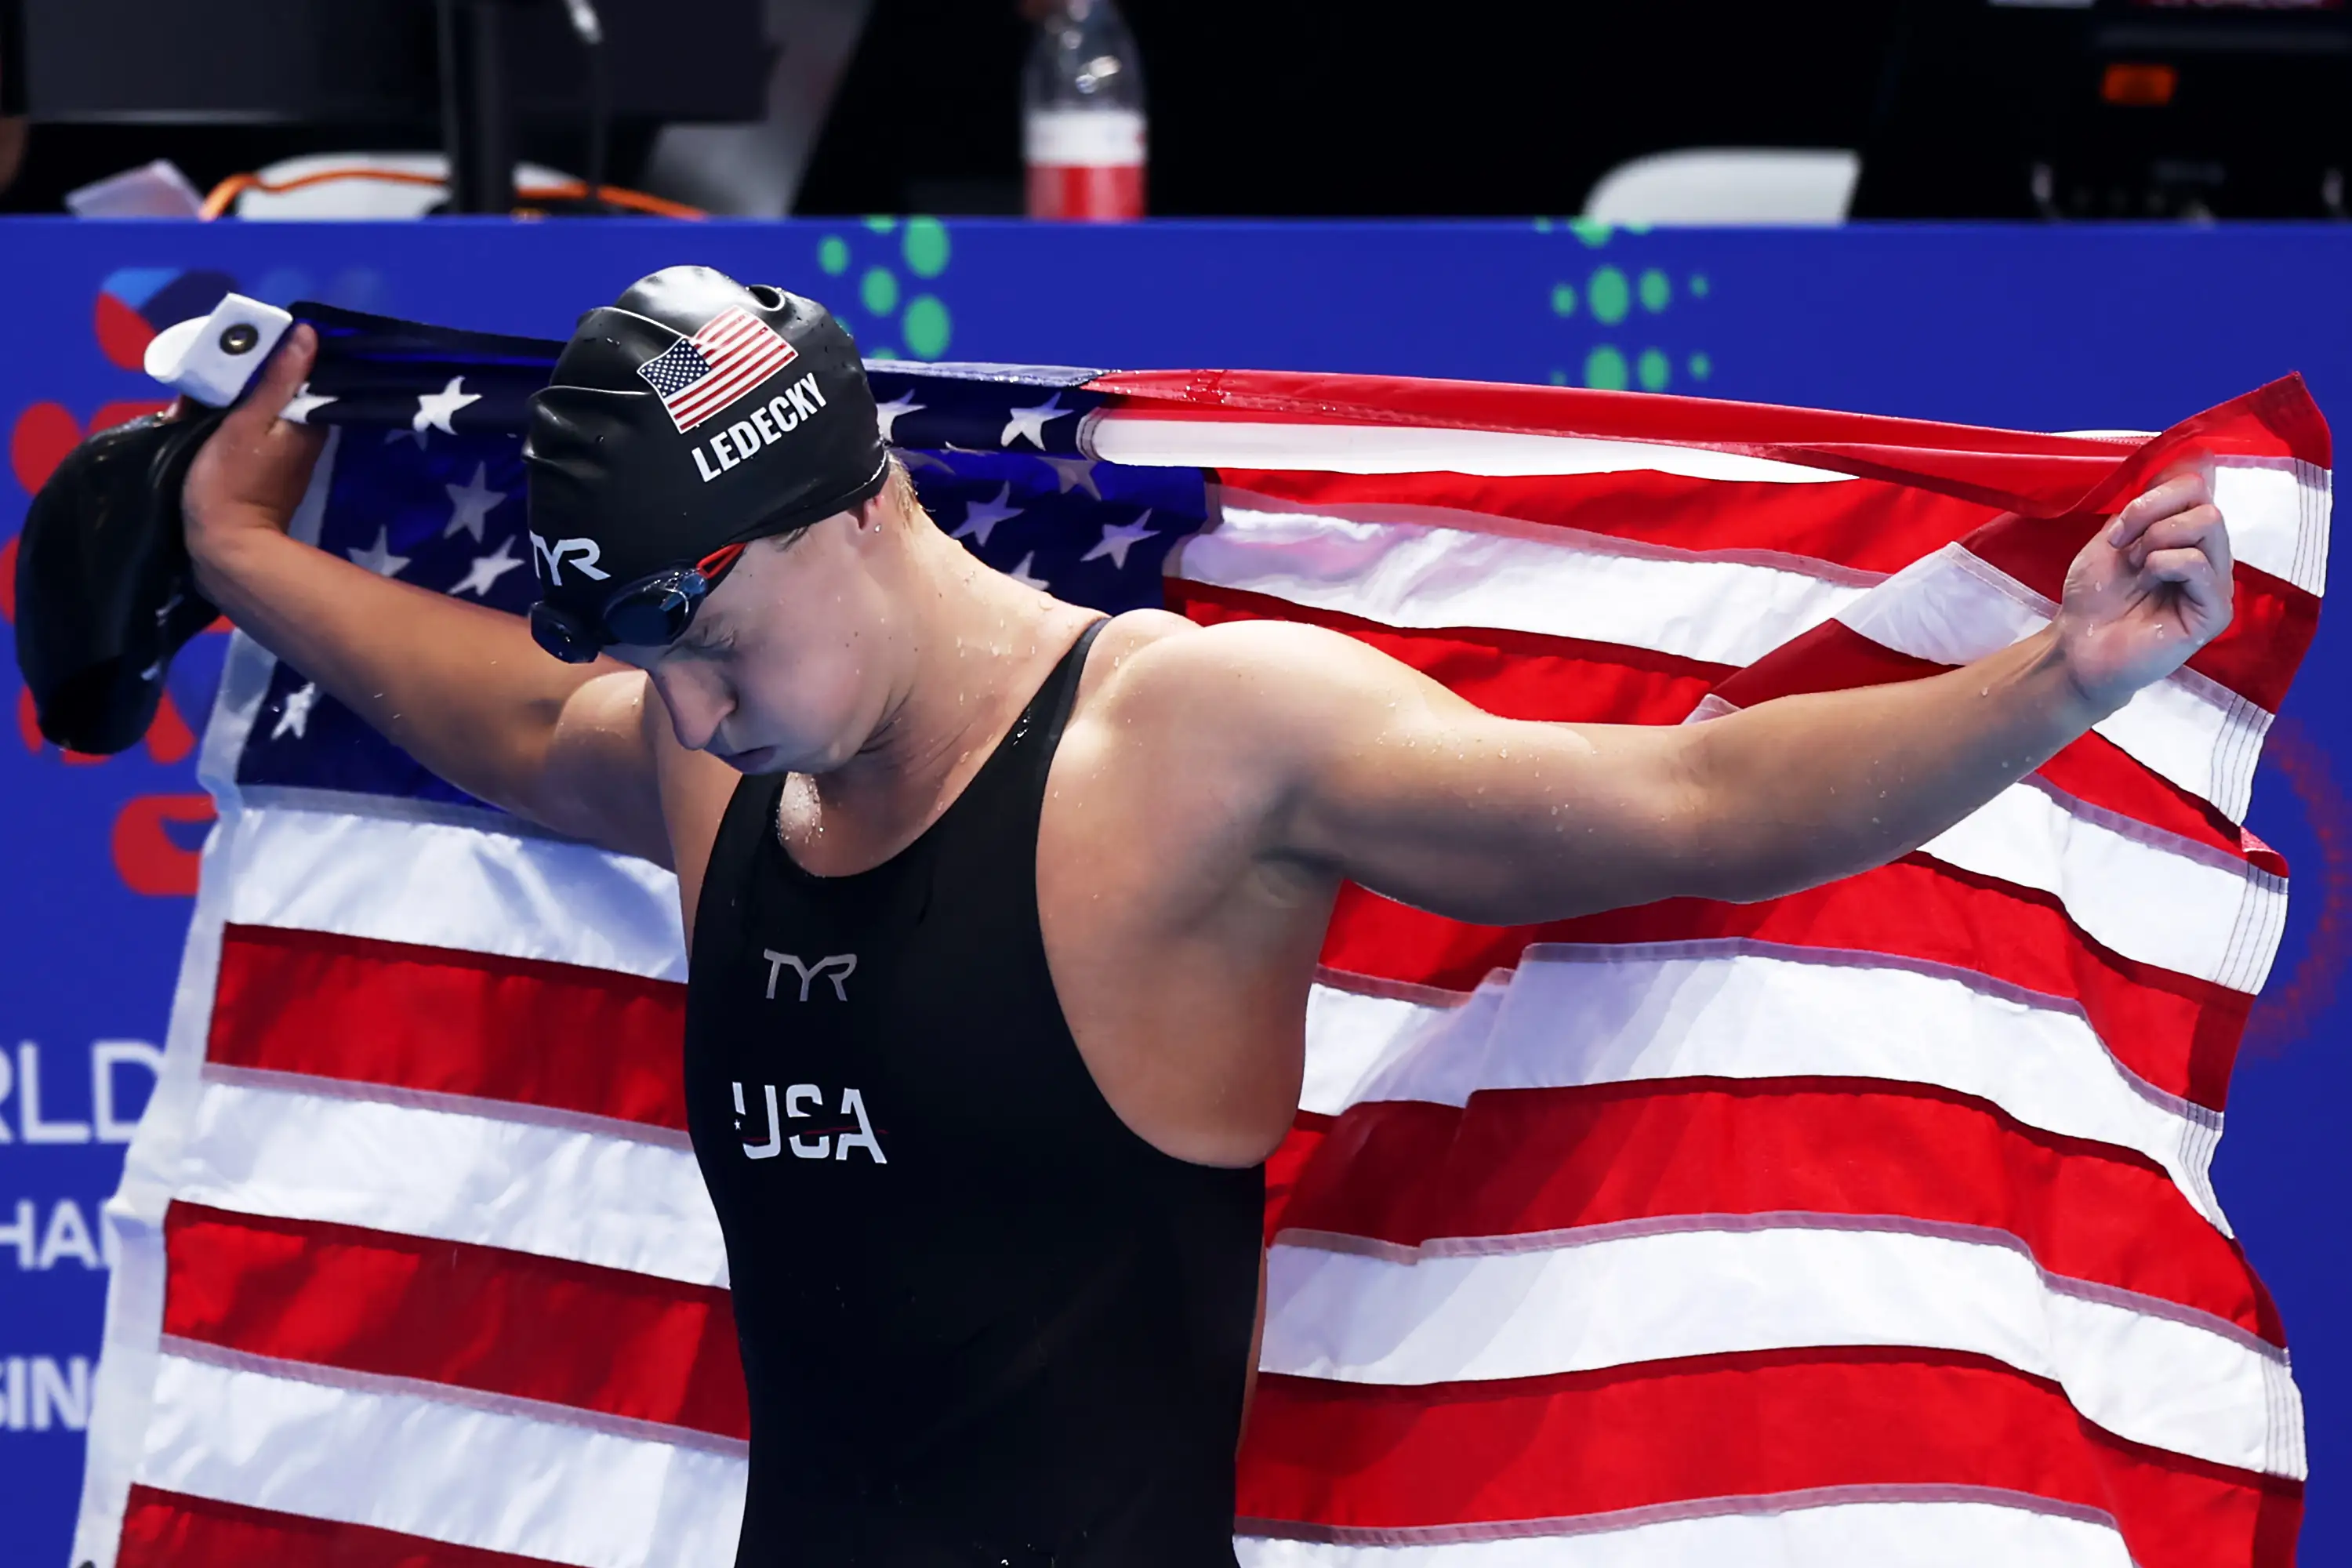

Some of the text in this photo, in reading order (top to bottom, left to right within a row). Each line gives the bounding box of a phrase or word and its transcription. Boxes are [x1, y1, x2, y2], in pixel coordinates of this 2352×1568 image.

[691, 372, 827, 482] LEDECKY
[764, 948, 858, 1002] TYR
[0, 1040, 166, 1144] LD
[732, 1081, 888, 1164] USA
